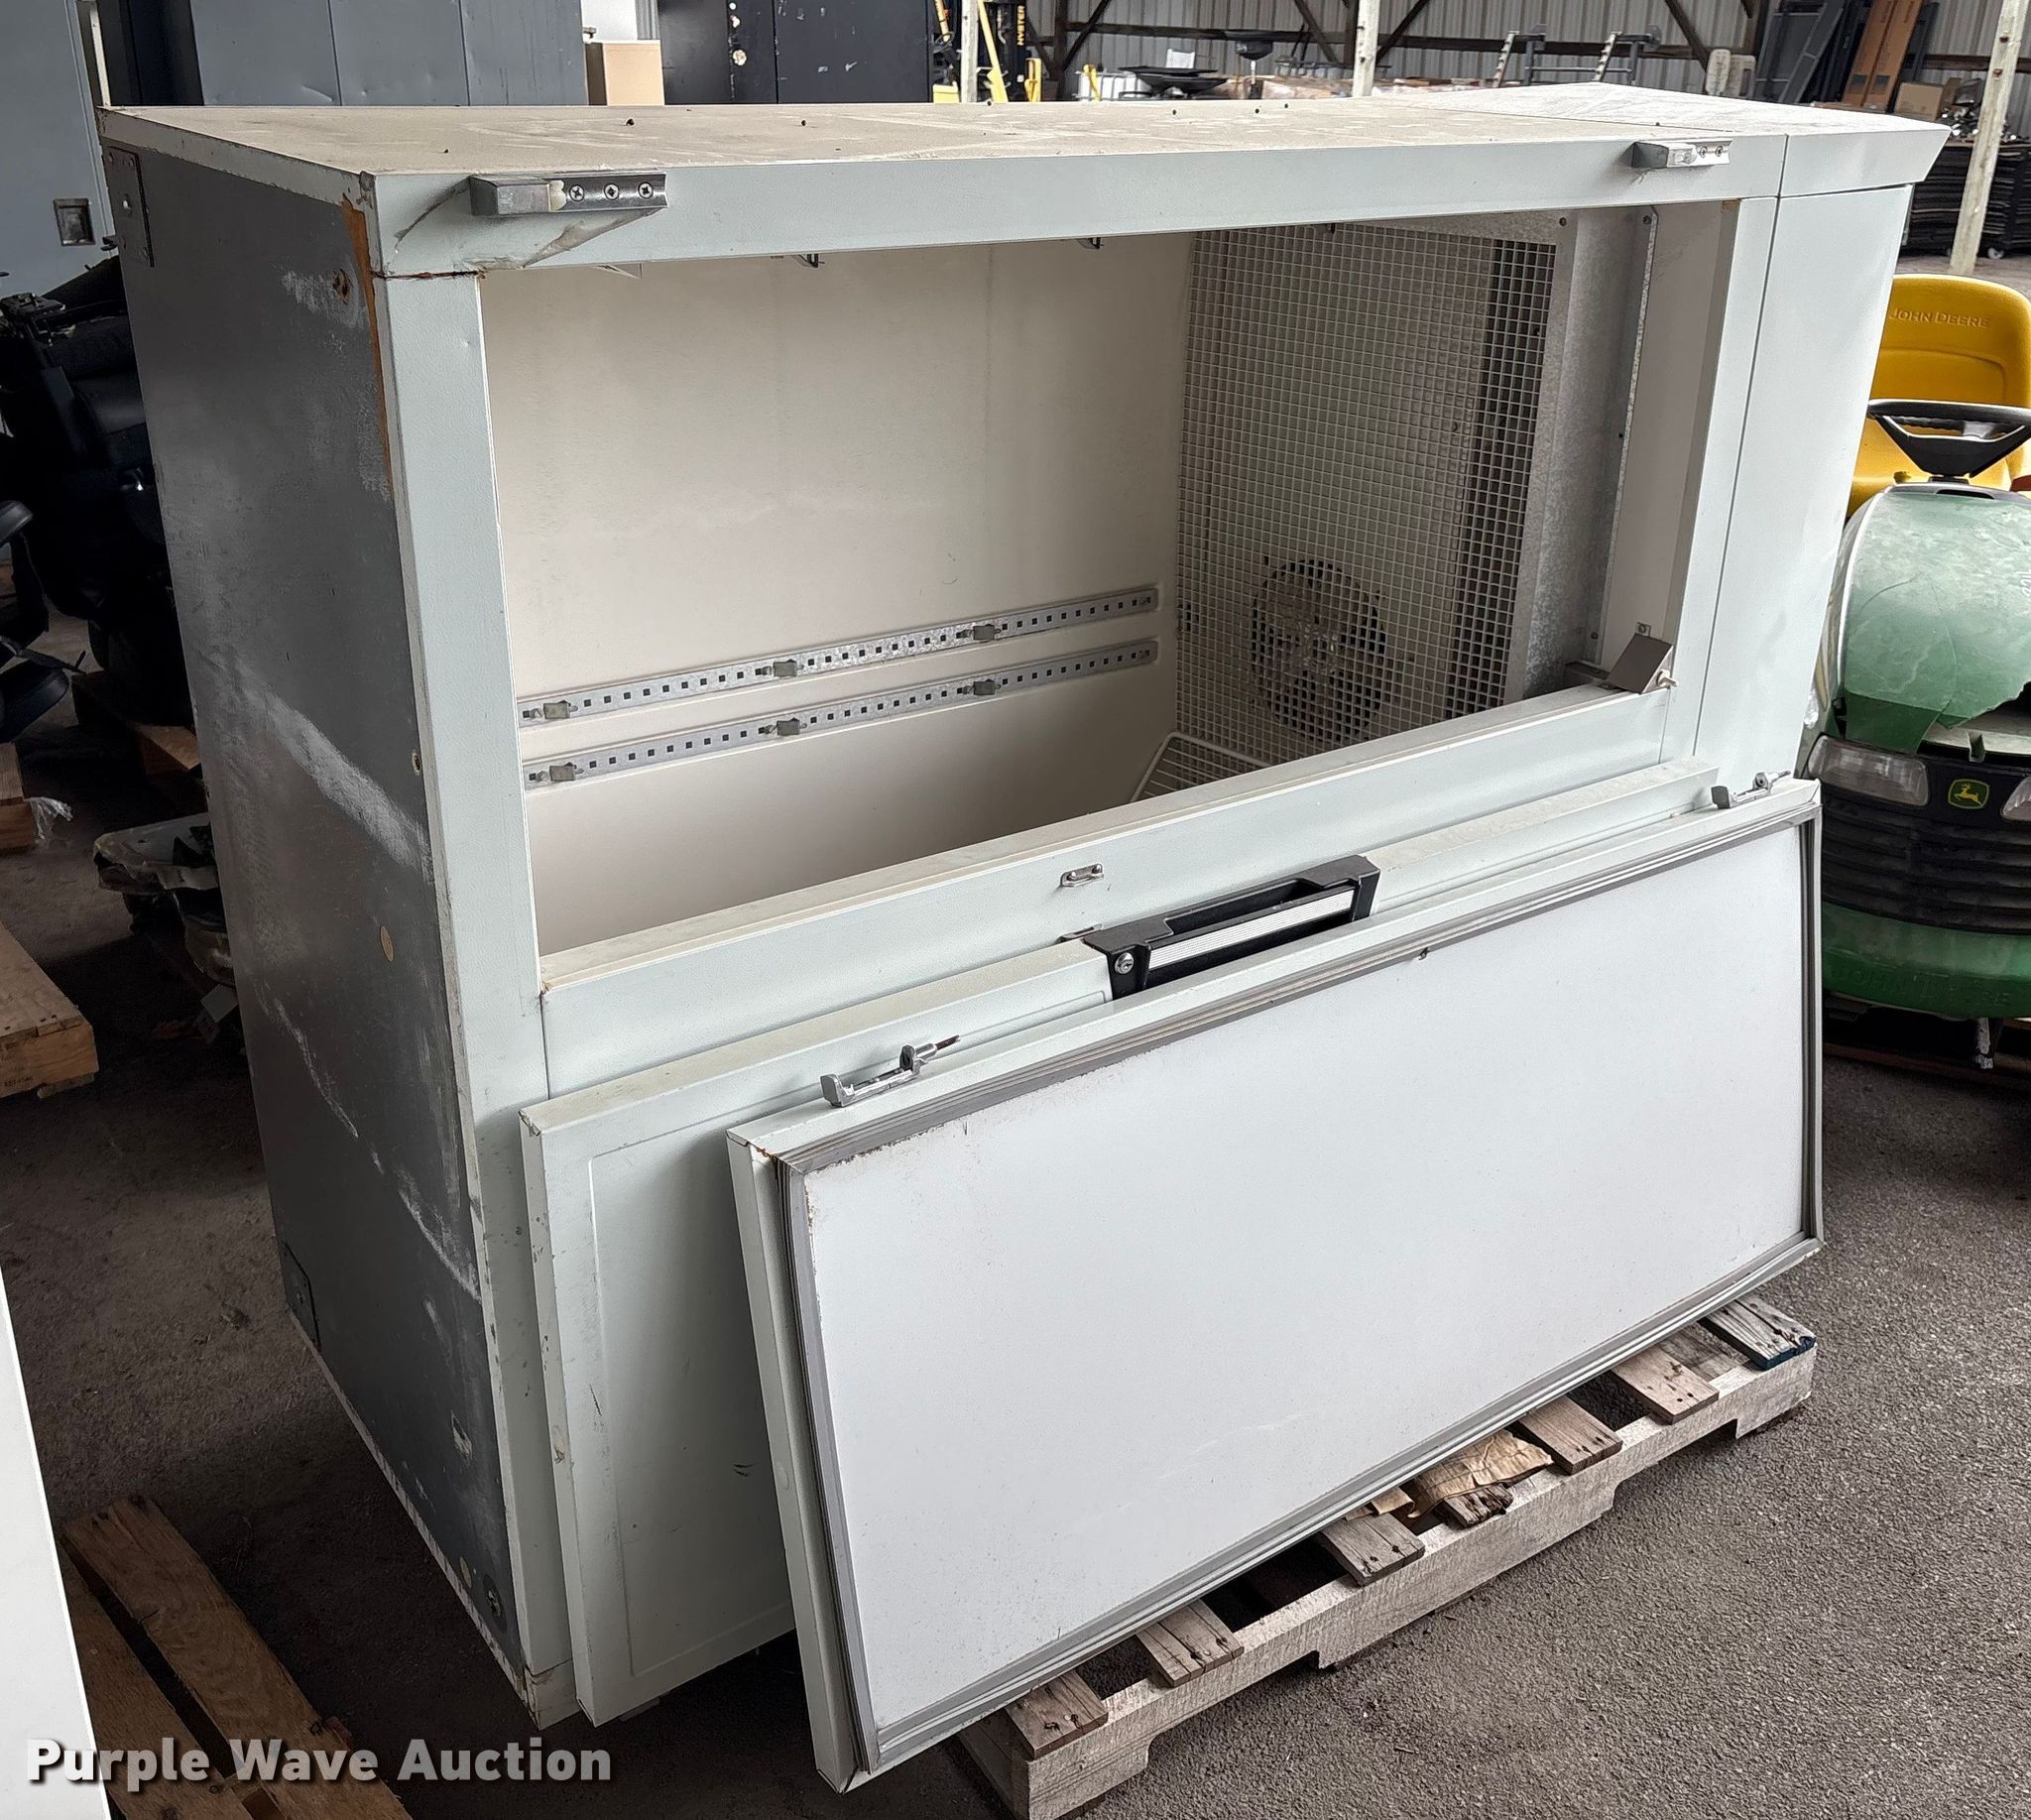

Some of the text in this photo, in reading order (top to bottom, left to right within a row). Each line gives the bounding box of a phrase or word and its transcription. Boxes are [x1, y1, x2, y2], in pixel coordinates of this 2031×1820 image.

[1016, 5, 1025, 46] HYSTER
[1888, 307, 1990, 328] JOHN DEERE
